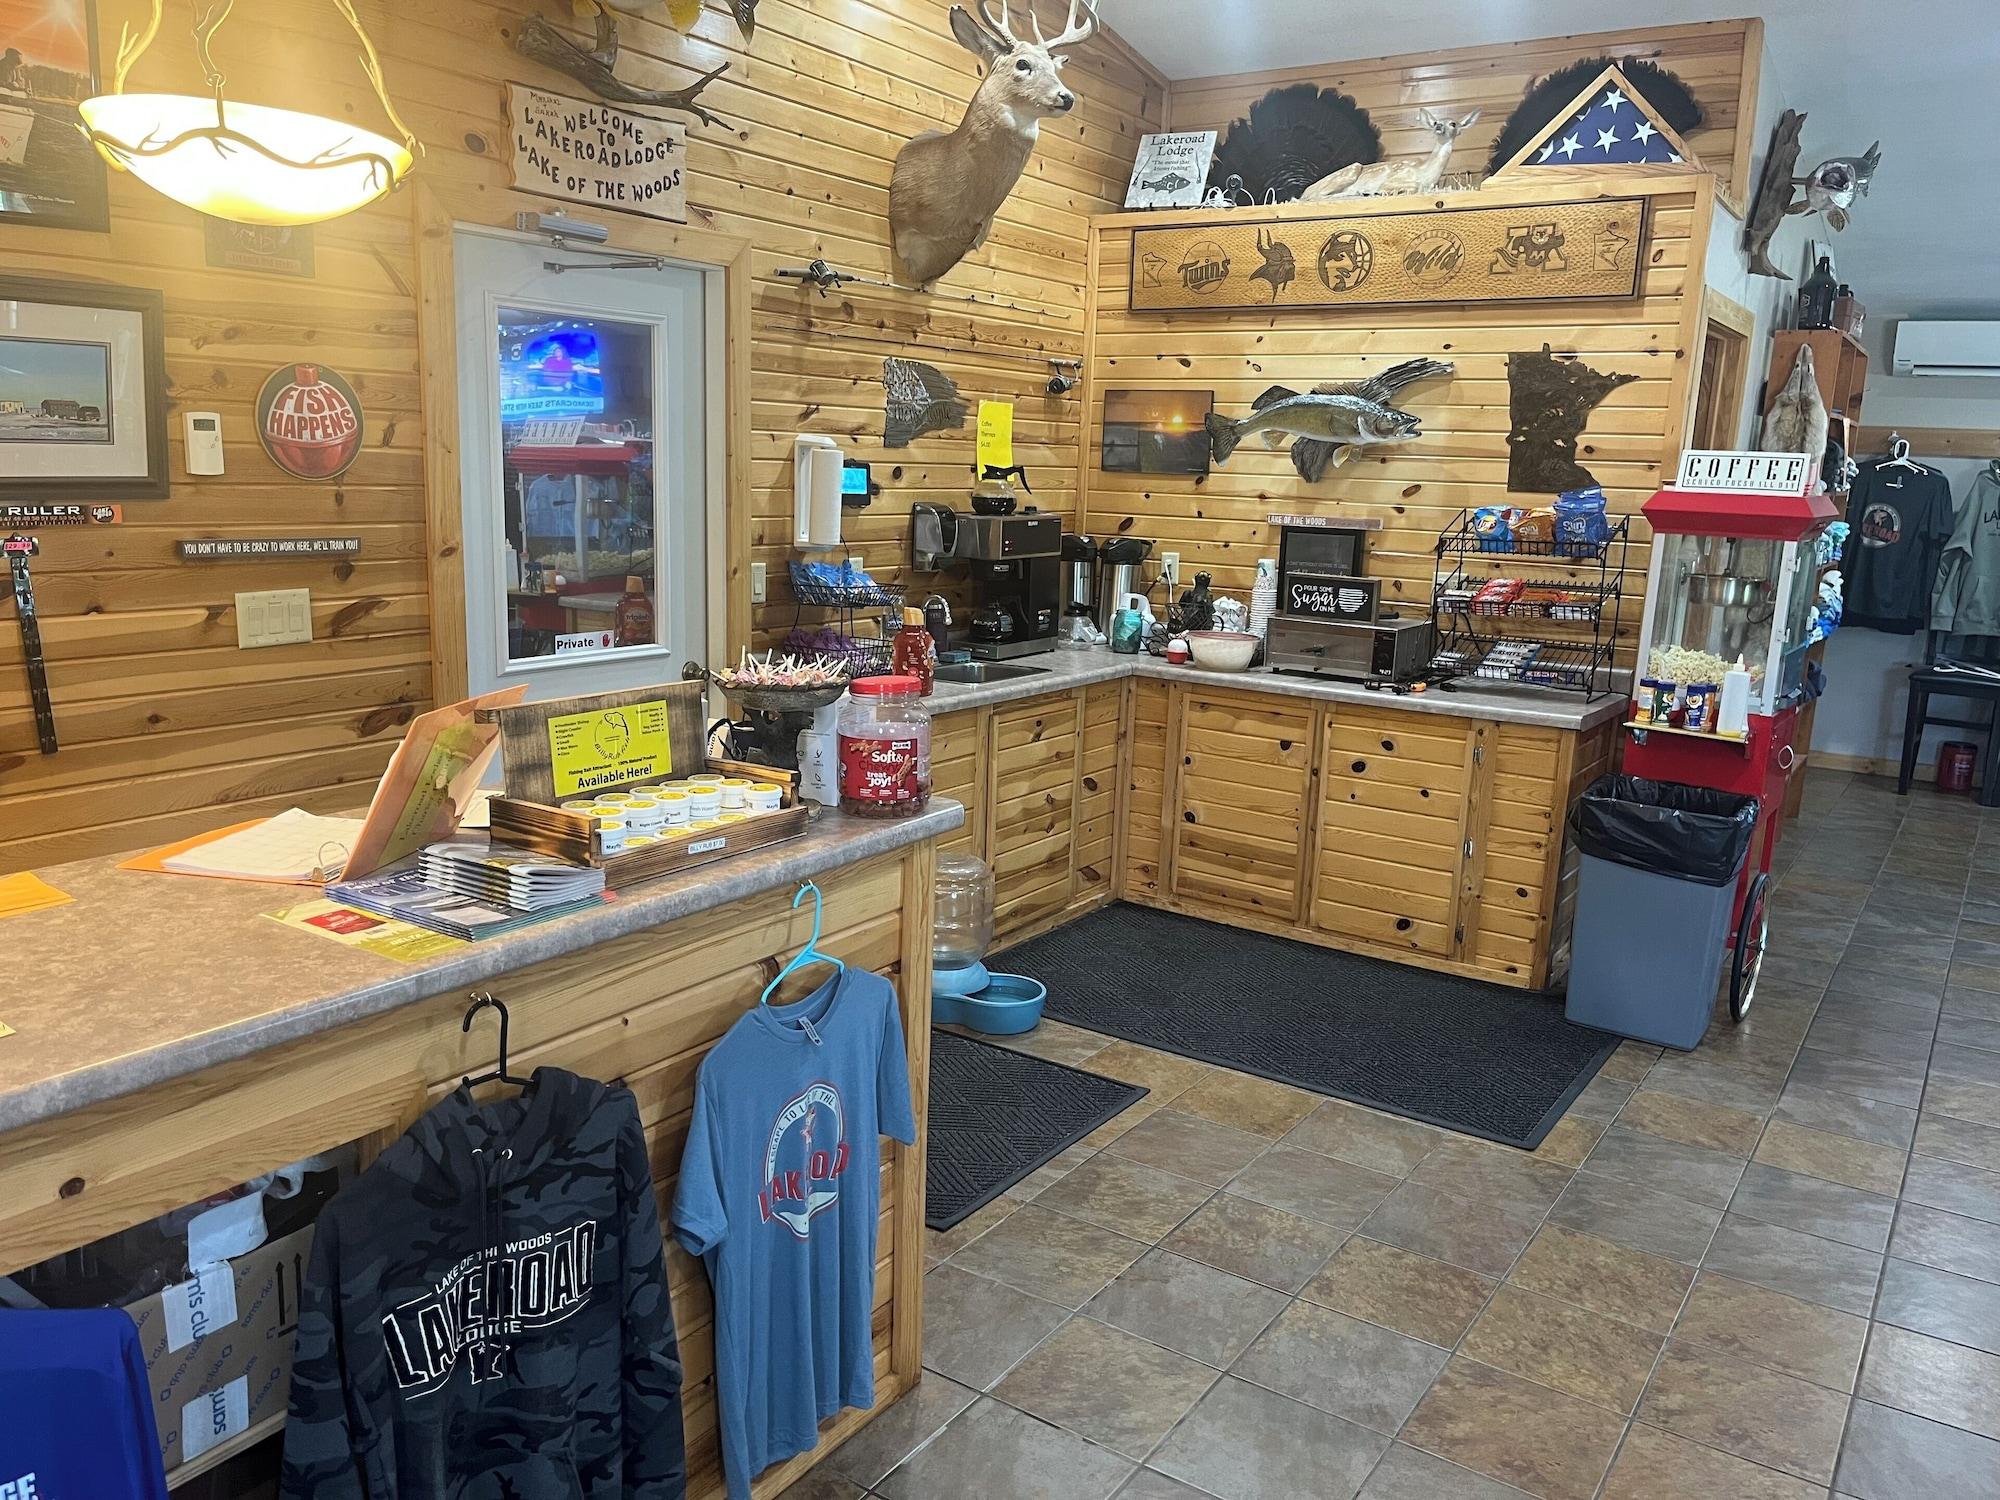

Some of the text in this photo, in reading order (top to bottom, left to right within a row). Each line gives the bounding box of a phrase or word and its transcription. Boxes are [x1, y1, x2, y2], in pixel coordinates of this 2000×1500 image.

[564, 108, 644, 145] WELCOME
[597, 128, 616, 147] TO
[1150, 133, 1206, 146] Lakeroad
[625, 137, 675, 166] LODGE
[1157, 145, 1194, 157] Lodge
[518, 135, 681, 202] LAKE OF THE WOODS
[1177, 258, 1231, 289] Twins
[274, 385, 348, 415] FISH
[269, 408, 356, 440] HAPPENS
[1688, 457, 1800, 481] COFFEE
[8, 506, 80, 515] RULER
[1268, 515, 1326, 526] LAKE OF THE WOODS
[184, 539, 358, 554] YOU DON'T HAVE TO BE CRAZY TO WORK HERE, WE'LL TRAIN YOU!
[1292, 584, 1339, 611] Sugar
[1304, 584, 1318, 592] POUR
[556, 638, 594, 650] Private
[578, 764, 652, 788] Available Here!
[868, 776, 892, 787] joy!
[784, 1110, 797, 1124] TO
[435, 1266, 458, 1294] LAKE
[460, 1254, 474, 1270] OF
[506, 1232, 552, 1253] WOODS
